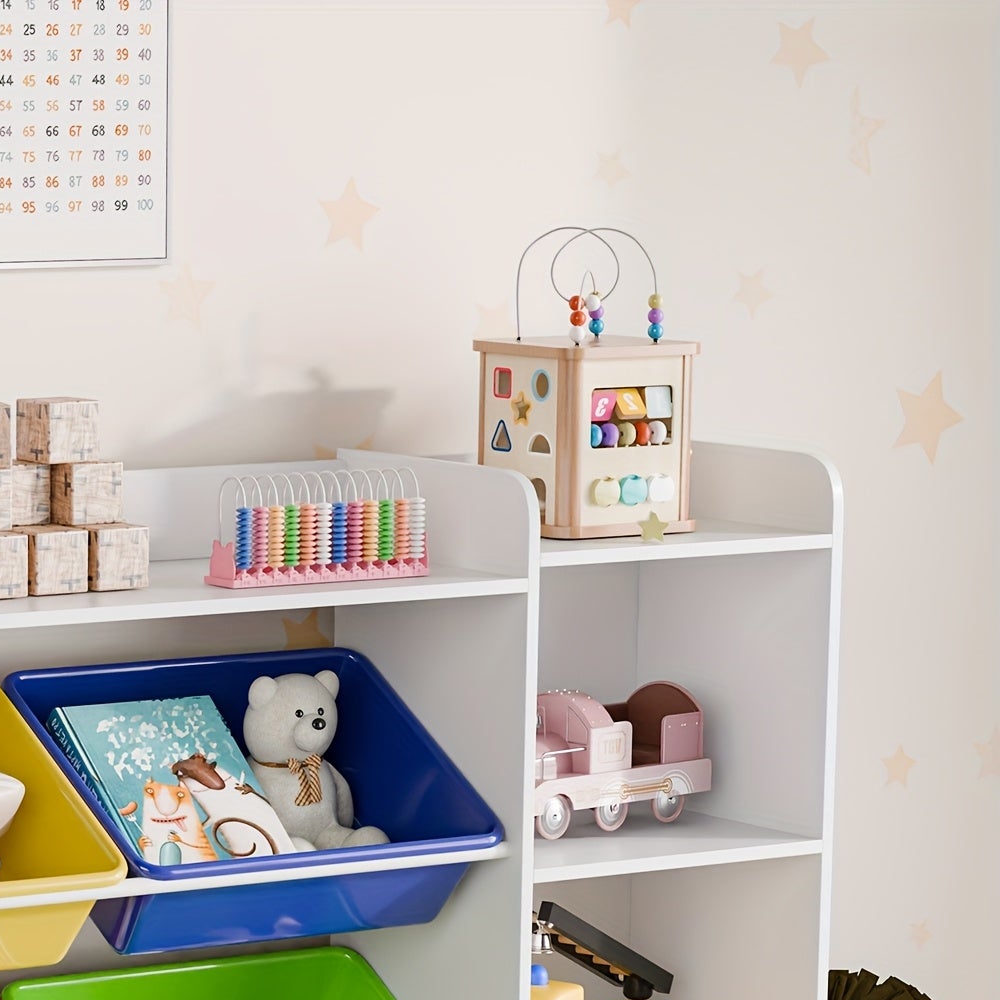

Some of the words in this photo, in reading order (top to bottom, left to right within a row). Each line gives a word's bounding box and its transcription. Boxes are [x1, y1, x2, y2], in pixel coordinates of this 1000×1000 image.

[1, 0, 11, 9] 14
[25, 0, 35, 10] 15
[48, 0, 59, 10] 16
[72, 0, 82, 10] 17
[96, 0, 105, 11] 18
[119, 0, 129, 11] 19
[140, 0, 152, 10] 20
[0, 24, 12, 36] 24
[24, 24, 35, 35] 25
[46, 24, 58, 36] 26
[70, 24, 83, 36] 27
[94, 24, 105, 35] 28
[117, 24, 129, 35] 29
[139, 24, 151, 35] 30
[0, 49, 12, 61] 34
[24, 50, 35, 62] 35
[47, 50, 58, 61] 36
[70, 49, 82, 61] 37
[93, 49, 104, 61] 38
[117, 48, 128, 60] 39
[138, 48, 151, 61] 40
[0, 75, 13, 86] 44
[23, 75, 36, 87] 45
[46, 75, 59, 86] 46
[70, 74, 82, 85] 47
[92, 74, 105, 84] 48
[115, 74, 129, 85] 49
[139, 74, 151, 85] 50
[0, 99, 12, 111] 54
[23, 100, 35, 112] 55
[47, 100, 59, 112] 56
[70, 100, 82, 111] 57
[93, 100, 105, 111] 58
[116, 100, 129, 111] 59
[138, 99, 150, 111] 60
[0, 126, 12, 137] 64
[23, 126, 35, 137] 65
[46, 126, 58, 136] 66
[69, 125, 82, 137] 67
[92, 125, 105, 136] 68
[115, 124, 128, 136] 69
[138, 124, 151, 136] 70
[0, 152, 13, 162] 74
[22, 151, 36, 163] 75
[46, 151, 59, 162] 76
[69, 150, 83, 161] 77
[93, 150, 104, 161] 78
[116, 150, 128, 161] 79
[139, 150, 151, 161] 80
[0, 177, 12, 189] 84
[23, 176, 35, 188] 85
[46, 176, 59, 188] 86
[69, 176, 82, 187] 87
[92, 175, 105, 187] 88
[115, 175, 128, 186] 89
[138, 175, 151, 185] 90
[22, 201, 36, 213] 95
[45, 201, 59, 212] 96
[68, 201, 82, 212] 97
[92, 200, 104, 212] 98
[115, 200, 128, 211] 99
[137, 199, 153, 210] 100
